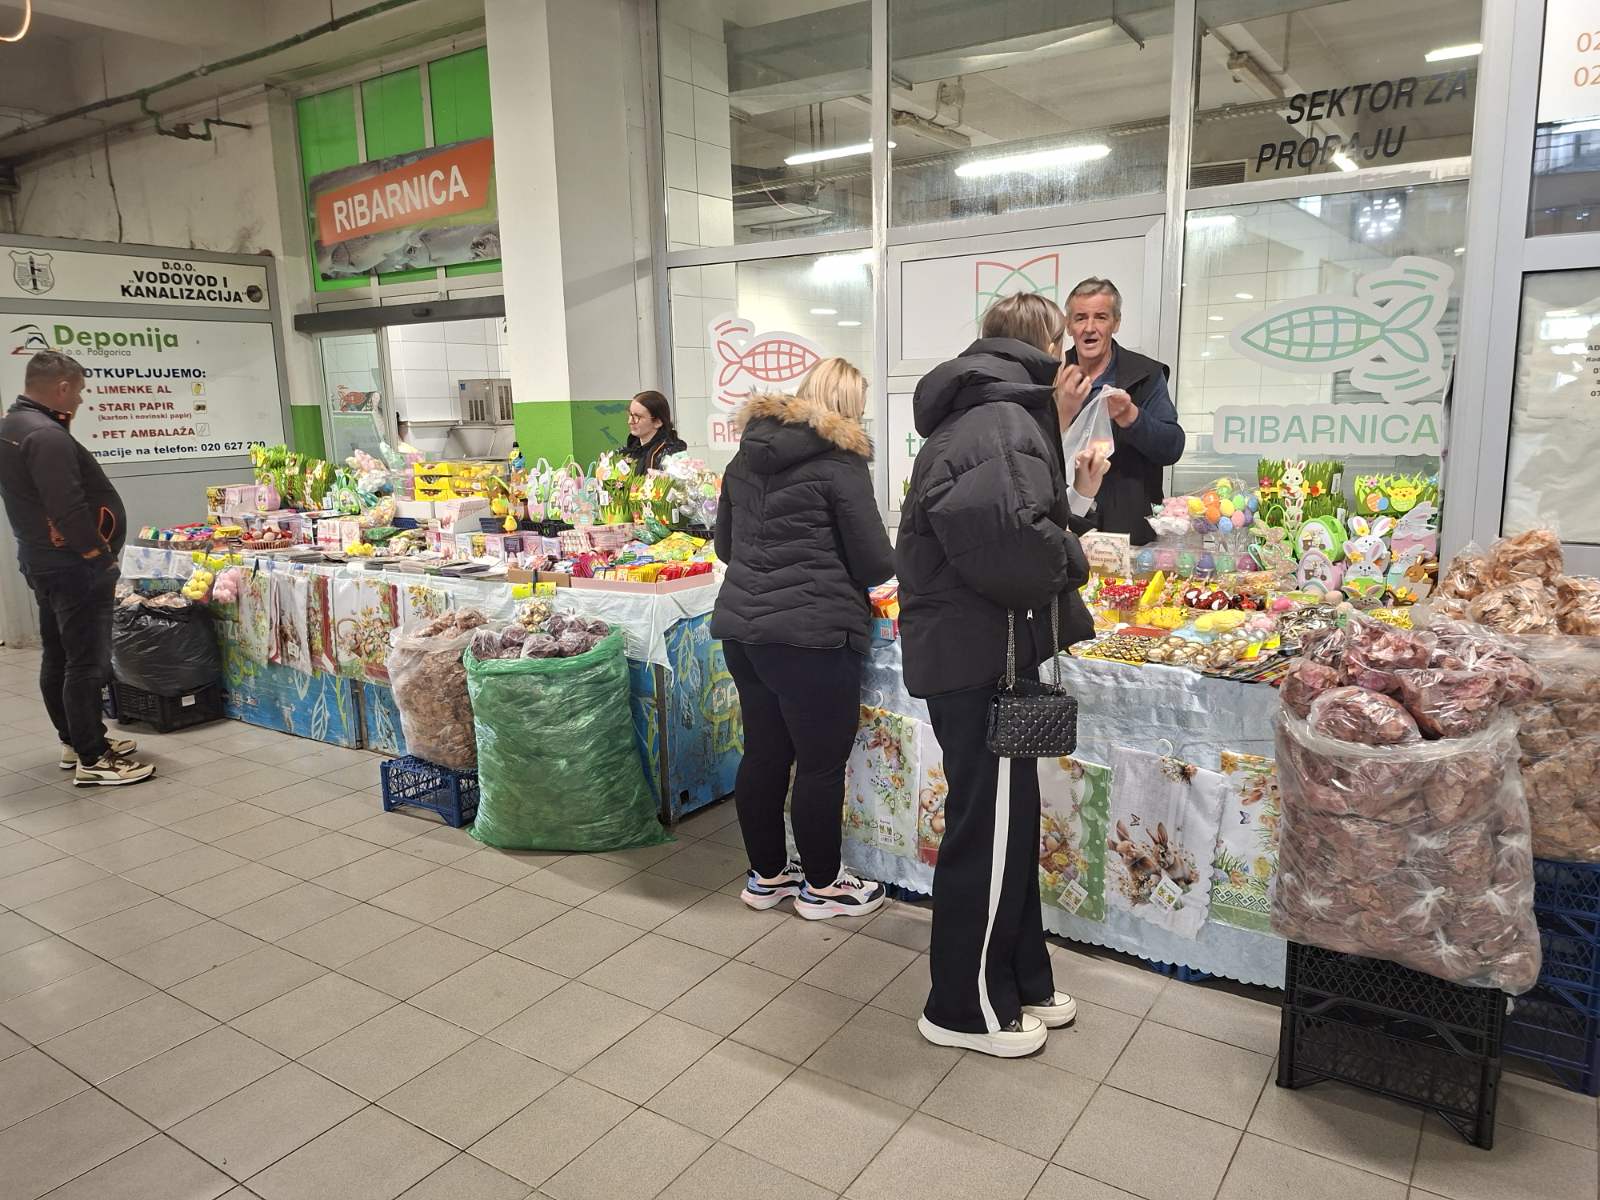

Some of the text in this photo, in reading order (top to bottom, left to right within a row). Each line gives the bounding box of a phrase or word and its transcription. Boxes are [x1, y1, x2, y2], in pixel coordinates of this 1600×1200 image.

[1286, 69, 1467, 125] SEKTOR ZA
[333, 165, 469, 233] RIBARNICA
[162, 261, 196, 272] D.O.O.
[223, 276, 228, 288] I
[54, 325, 179, 352] Deponija
[87, 348, 131, 357] Podgorica
[84, 368, 206, 378] OTKUPLJUJEMO:
[97, 386, 153, 394] LIMENKE
[99, 402, 174, 411] STARI PAPIR
[103, 426, 196, 438] PET AMBALAŽA
[1223, 414, 1440, 444] RIBARNICA
[154, 445, 198, 454] telefon:
[201, 443, 220, 451] 020
[224, 442, 243, 450] 627
